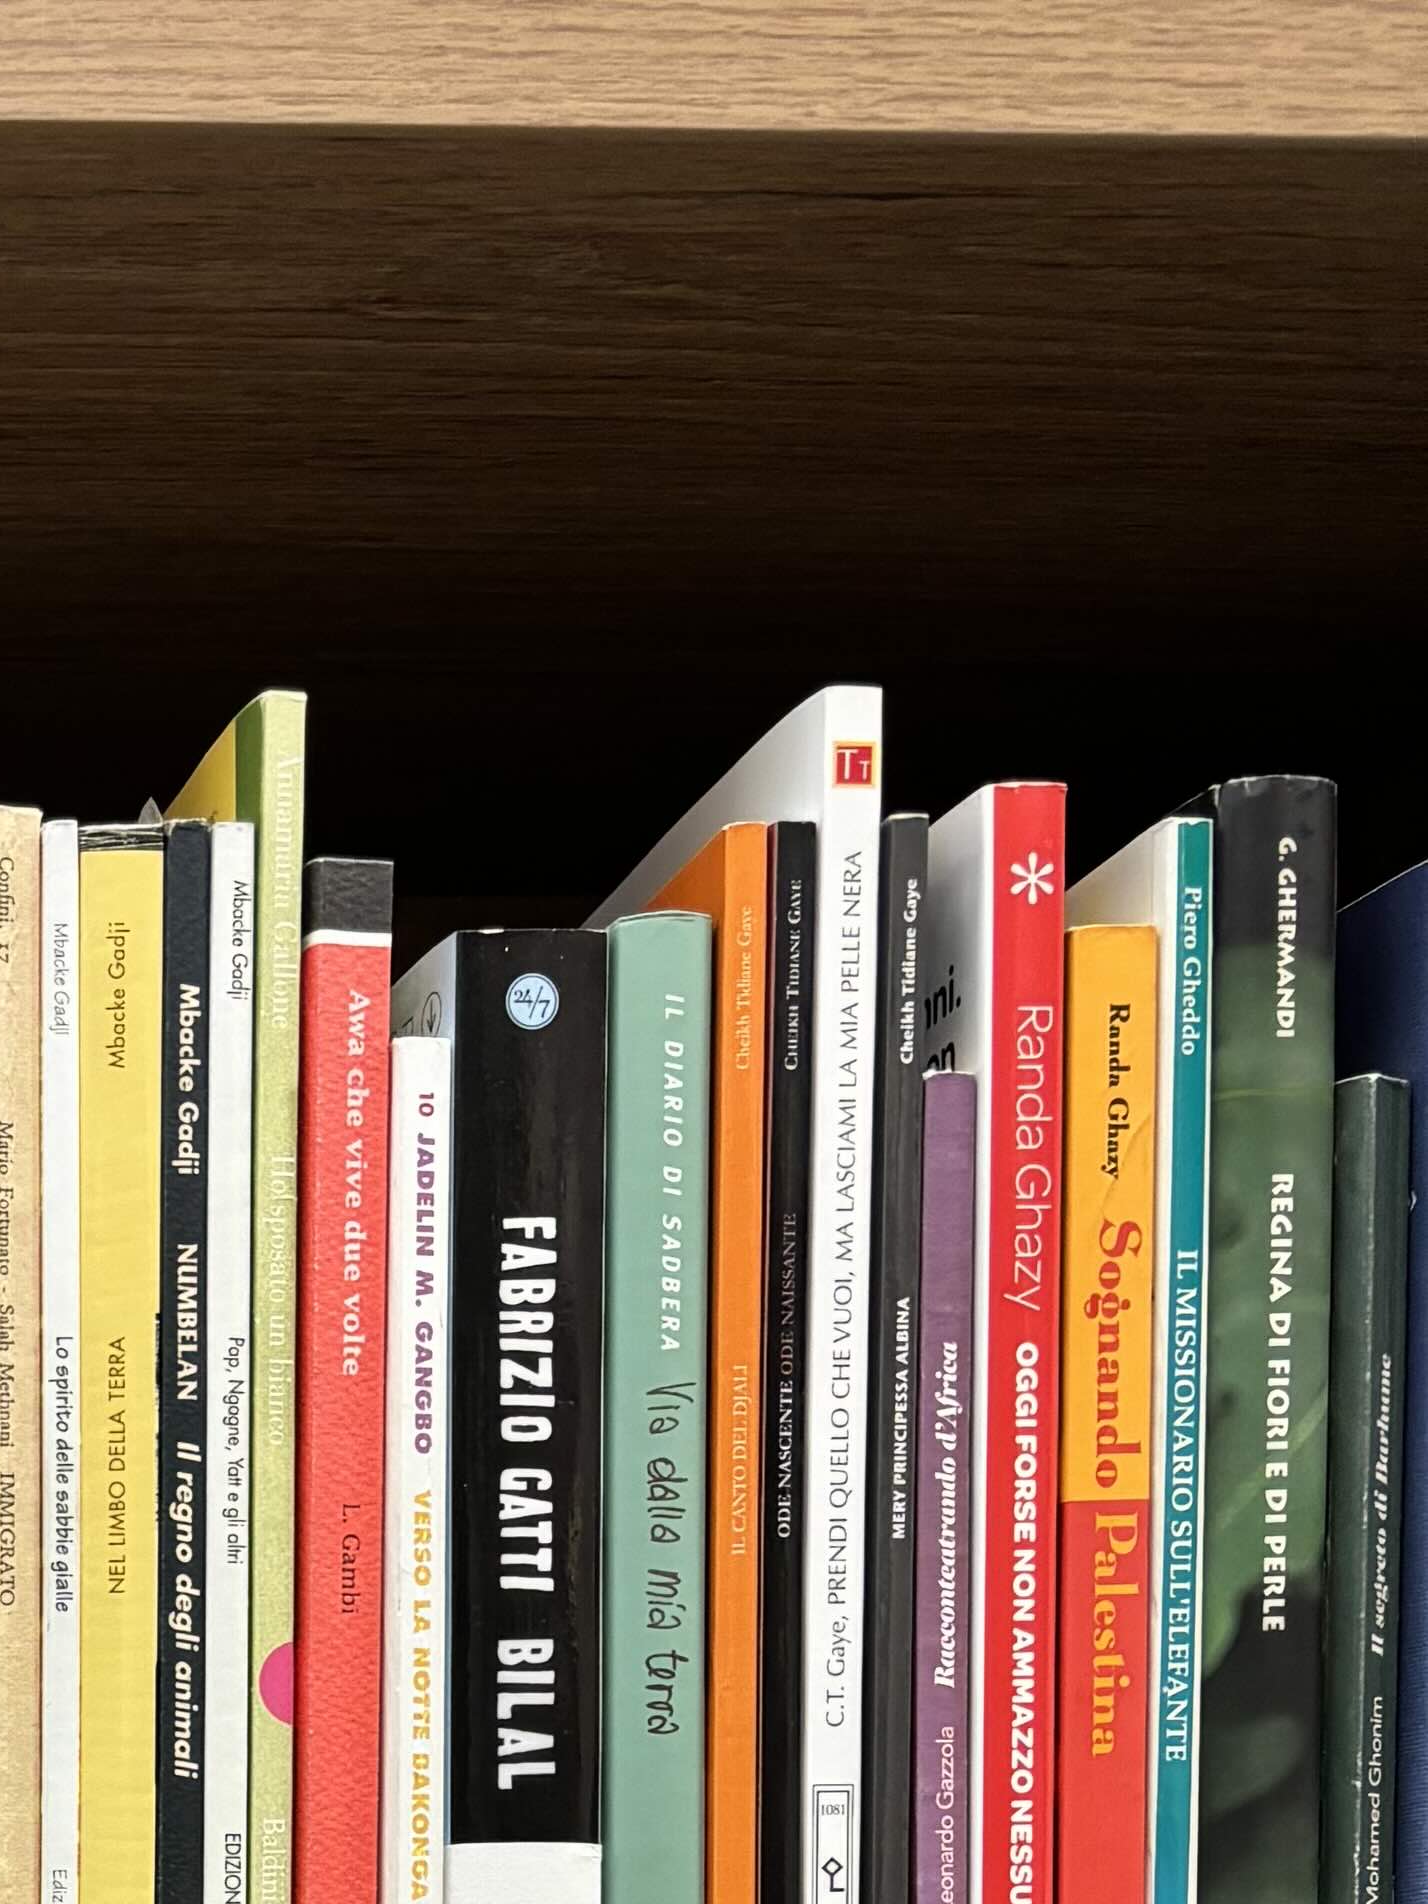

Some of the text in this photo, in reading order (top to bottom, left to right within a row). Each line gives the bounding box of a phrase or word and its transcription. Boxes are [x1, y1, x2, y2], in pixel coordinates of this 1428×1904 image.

[343, 990, 370, 1375] Awa che vive due volte
[177, 1244, 198, 1400] NUMBELAN
[1015, 1342, 1038, 1427] OGGI
[1084, 1218, 1142, 1489] Sognando
[1263, 1174, 1294, 1630] REGINA DI FIORI E DI PERLE
[497, 1217, 557, 1790] FABRIZIO GATTI BILAL
[645, 1382, 697, 1735] Via dalla mia terra
[1013, 1549, 1035, 1621] NON
[1014, 1435, 1037, 1542] FORSE
[1011, 1628, 1034, 1793] AMMAZZO
[1092, 1513, 1139, 1756] Palestina
